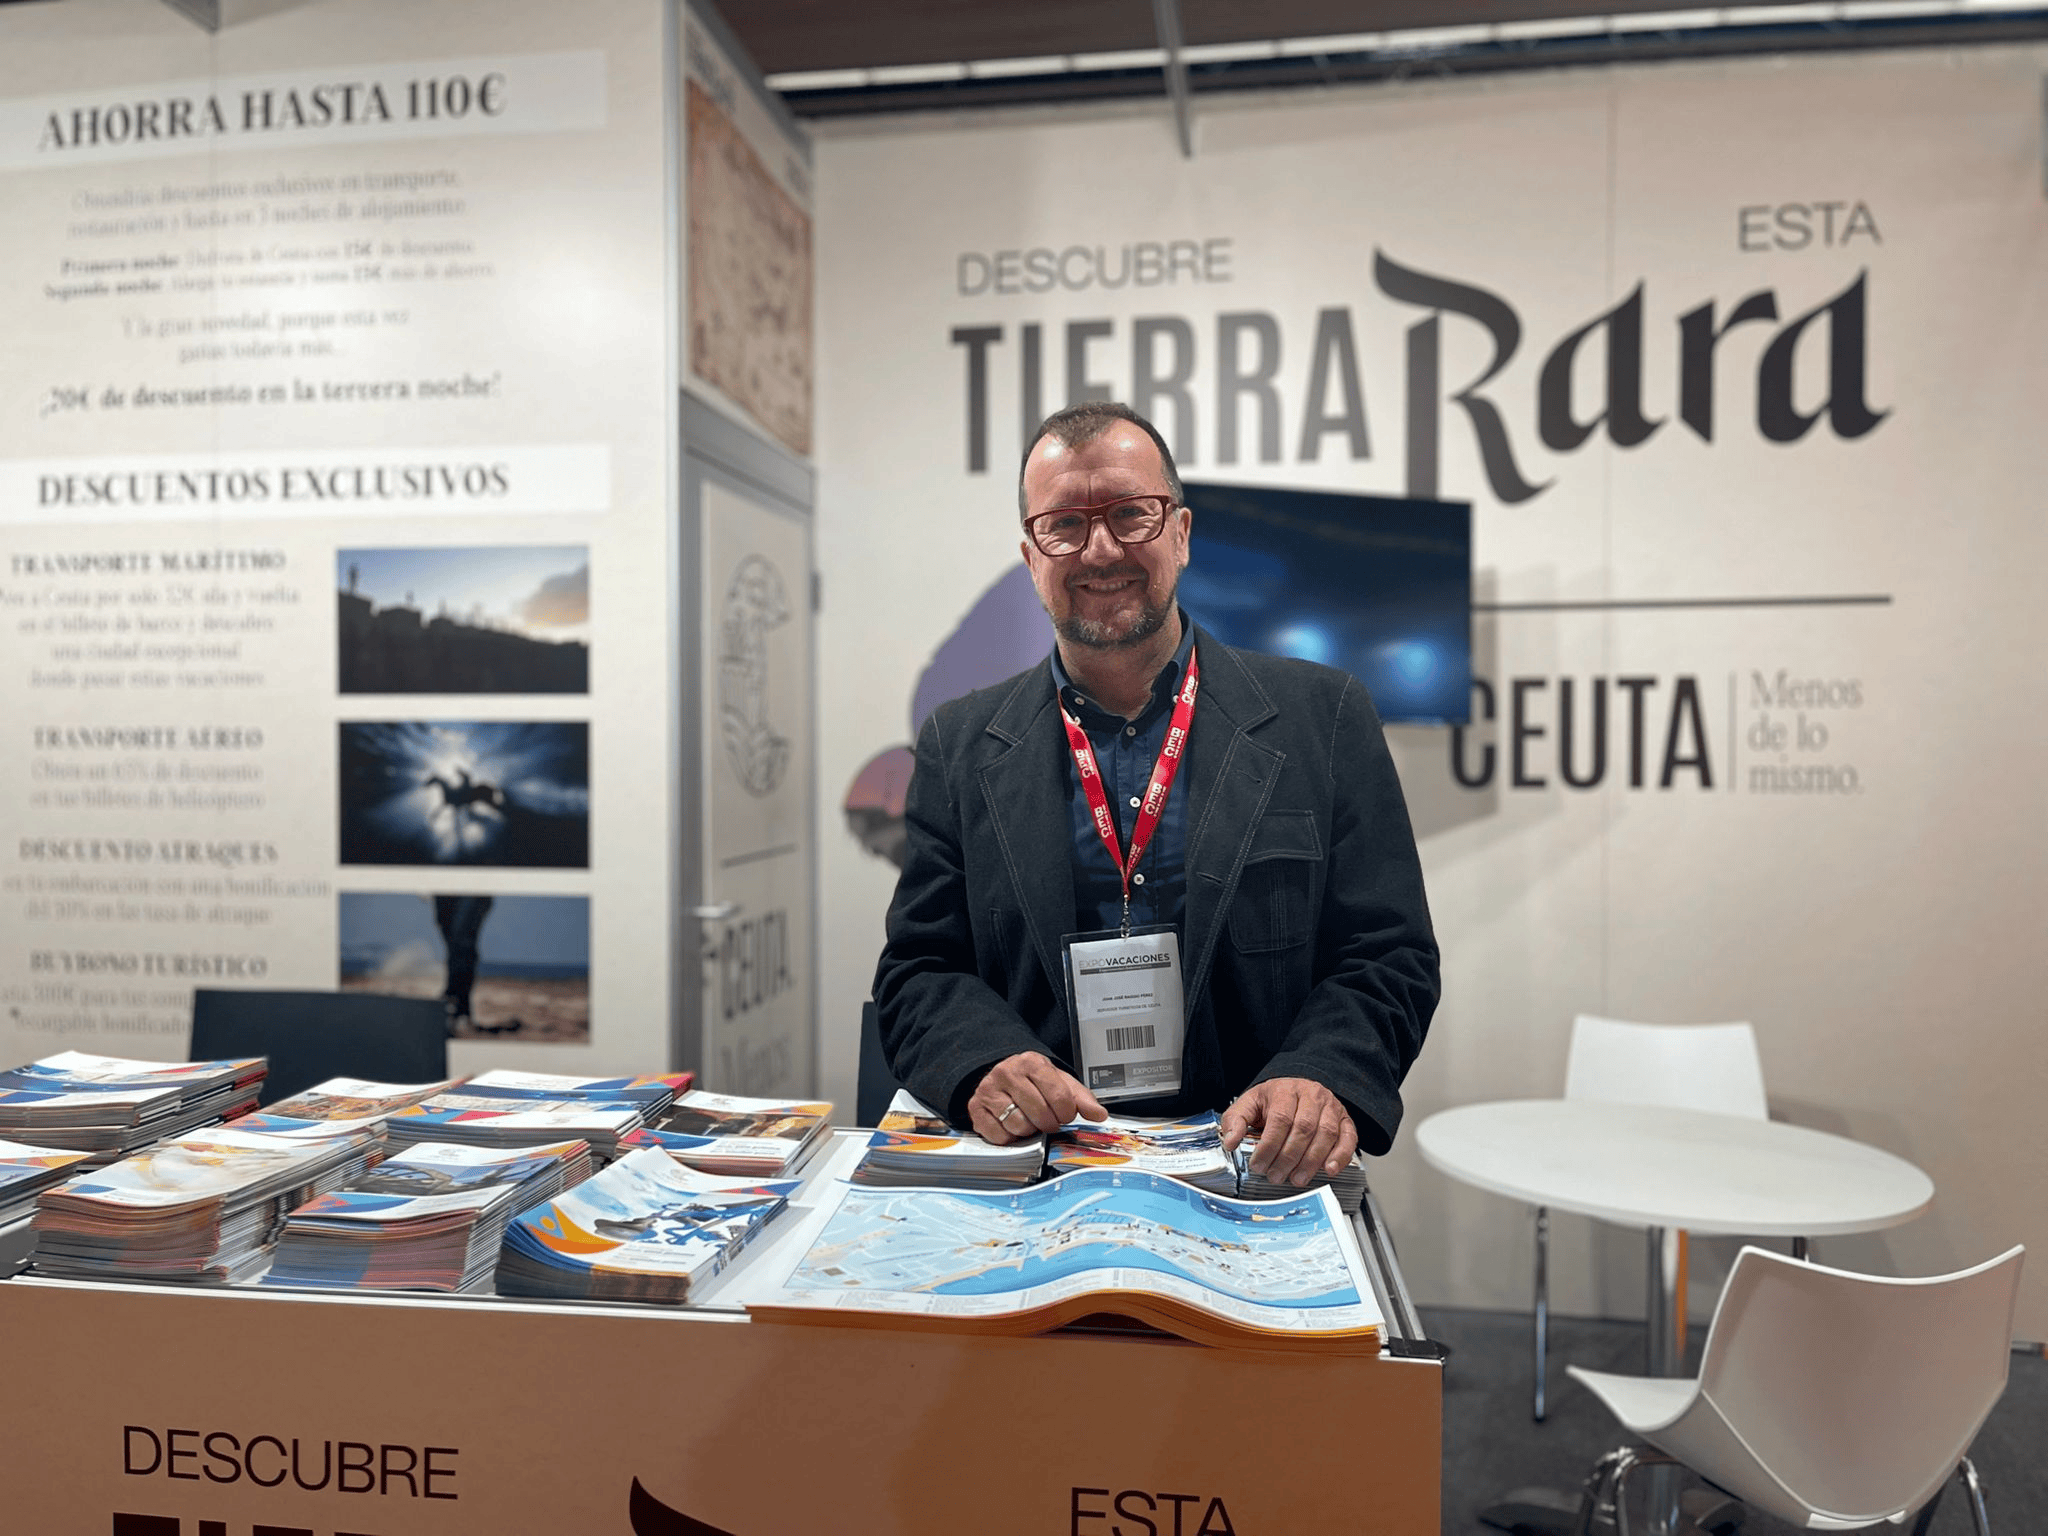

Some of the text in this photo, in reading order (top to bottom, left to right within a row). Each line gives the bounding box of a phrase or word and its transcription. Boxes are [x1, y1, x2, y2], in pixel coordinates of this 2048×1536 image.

[37, 73, 507, 152] AHORRA HASTA 110€
[1736, 200, 1884, 253] ESTA
[956, 237, 1234, 297] DESCUBRE
[1372, 243, 1893, 507] Rara
[38, 463, 510, 508] DESCUENTOS EXCLUSIVOS
[1749, 668, 1864, 710] Menos
[1448, 675, 1716, 791] CEUTA
[1748, 713, 1830, 752] de lo
[123, 1425, 460, 1501] DESCUBRE
[1071, 1486, 1237, 1536] ESTA
